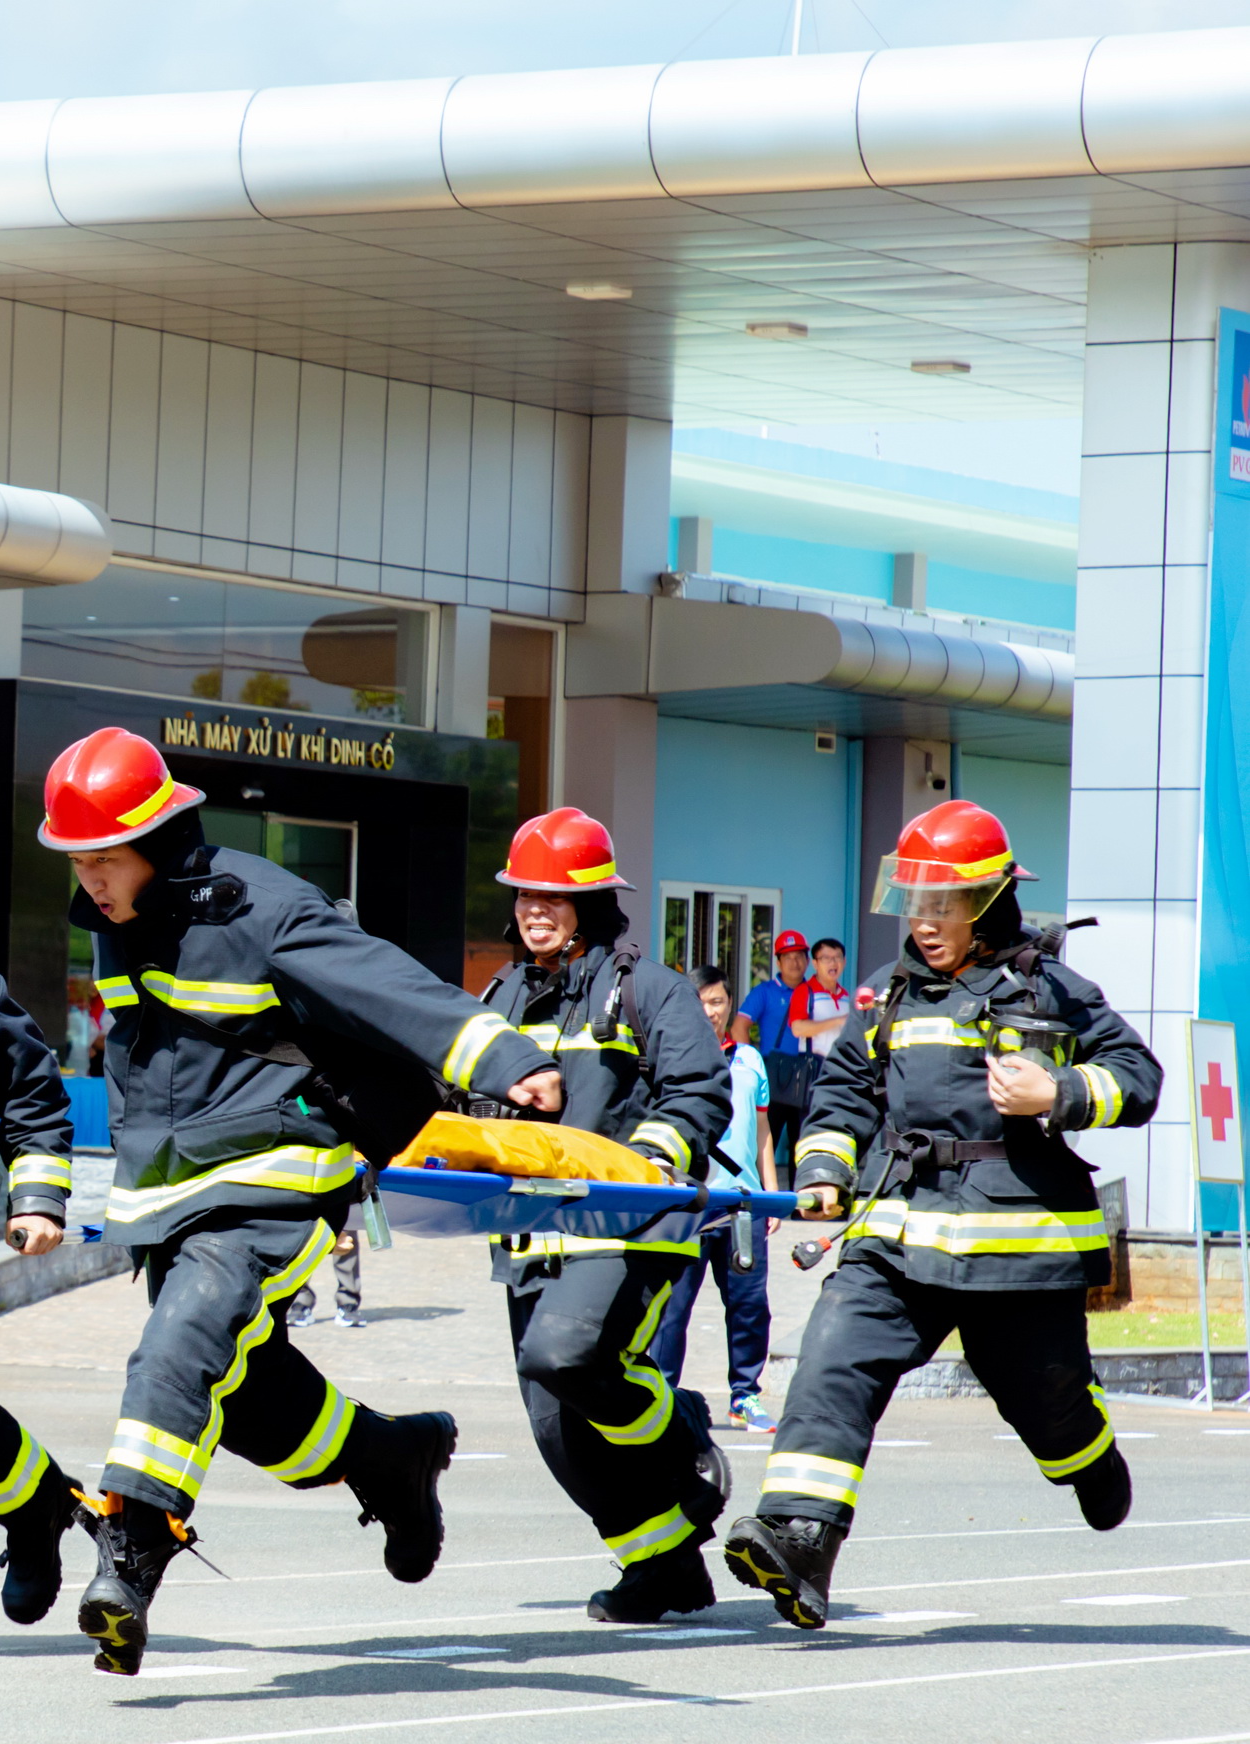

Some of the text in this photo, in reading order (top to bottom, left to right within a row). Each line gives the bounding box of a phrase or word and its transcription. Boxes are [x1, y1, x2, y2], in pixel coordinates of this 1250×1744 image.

[202, 714, 241, 753] MÁY
[276, 722, 295, 759] LÝ
[300, 727, 326, 763] KHÍ
[330, 737, 365, 767] DINH
